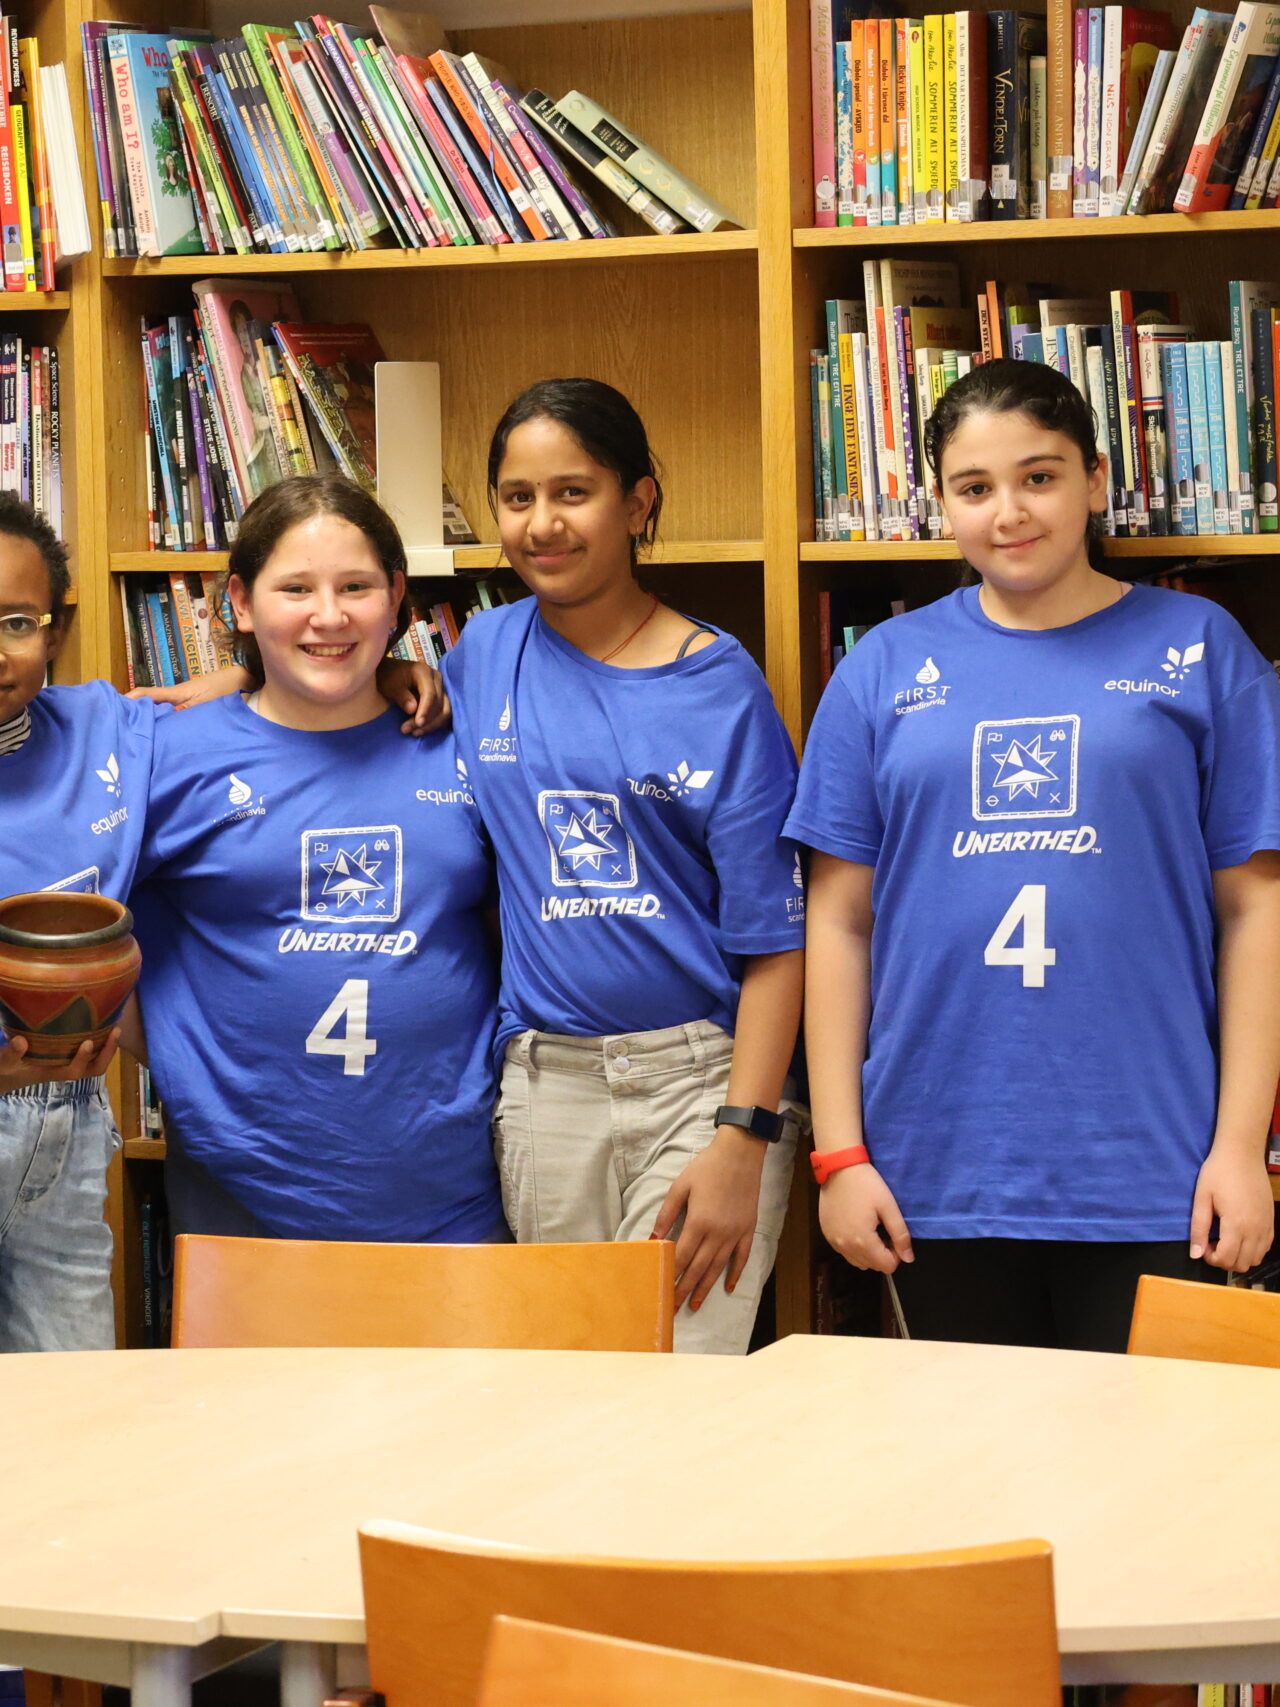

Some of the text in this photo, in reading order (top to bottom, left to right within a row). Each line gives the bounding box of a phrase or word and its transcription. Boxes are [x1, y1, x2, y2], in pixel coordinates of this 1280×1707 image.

[10, 28, 20, 87] REVISION EXPRESS
[142, 47, 168, 67] Who
[880, 59, 888, 81] Diabolo
[1055, 48, 1064, 85] STORE
[202, 86, 217, 117] RENOIR
[897, 65, 906, 110] Ricky knipe
[959, 94, 965, 102] EN
[115, 63, 139, 150] Who am I?
[928, 81, 938, 153] SOMMEREN ALT
[947, 81, 958, 153] SOMMEREN ALT
[15, 109, 23, 149] GEOGRAPHY
[960, 125, 966, 133] EN
[1104, 140, 1113, 168] GRATA
[0, 145, 12, 204] REISEBOKEN
[978, 310, 987, 325] DEN
[828, 321, 841, 407] Runar Bang TRE TRE
[1231, 306, 1245, 392] Runar Bang TRE TRE
[51, 411, 59, 439] ROCKY
[151, 399, 165, 457] WINSTON CHURCHILL
[202, 418, 218, 464] STEVE JOBS
[842, 384, 860, 496] LENGE LEVE FANTASIEN
[161, 612, 180, 677] AMAZING HISTORY
[894, 684, 951, 705] FIRST
[1104, 678, 1181, 698] equinor
[479, 737, 516, 752] FIRST
[479, 753, 517, 763] scandinavia
[416, 788, 475, 807] equino
[626, 778, 674, 802] quinor
[90, 806, 129, 836] equinor
[952, 825, 1098, 858] UNEARTHED
[785, 896, 804, 914] FIR
[278, 928, 418, 956] UNEARTHED
[984, 884, 1056, 988] 4
[305, 979, 376, 1076] 4
